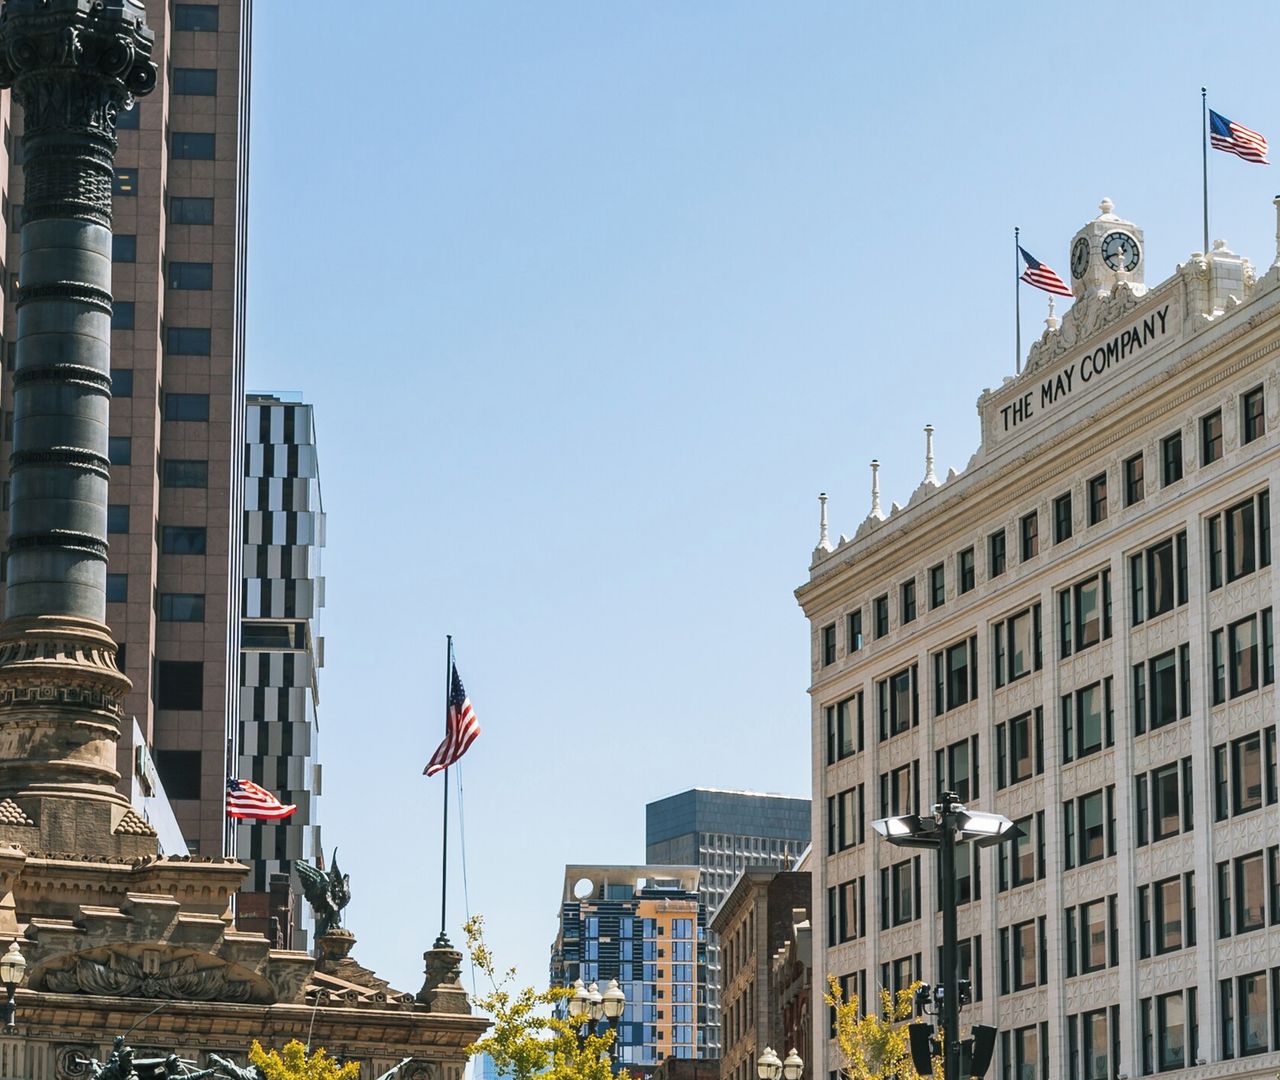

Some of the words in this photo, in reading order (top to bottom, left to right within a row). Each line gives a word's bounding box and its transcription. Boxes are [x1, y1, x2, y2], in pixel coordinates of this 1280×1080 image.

[1000, 392, 1033, 431] THE
[1041, 364, 1075, 409] MAY
[1080, 305, 1170, 382] COMPANY
